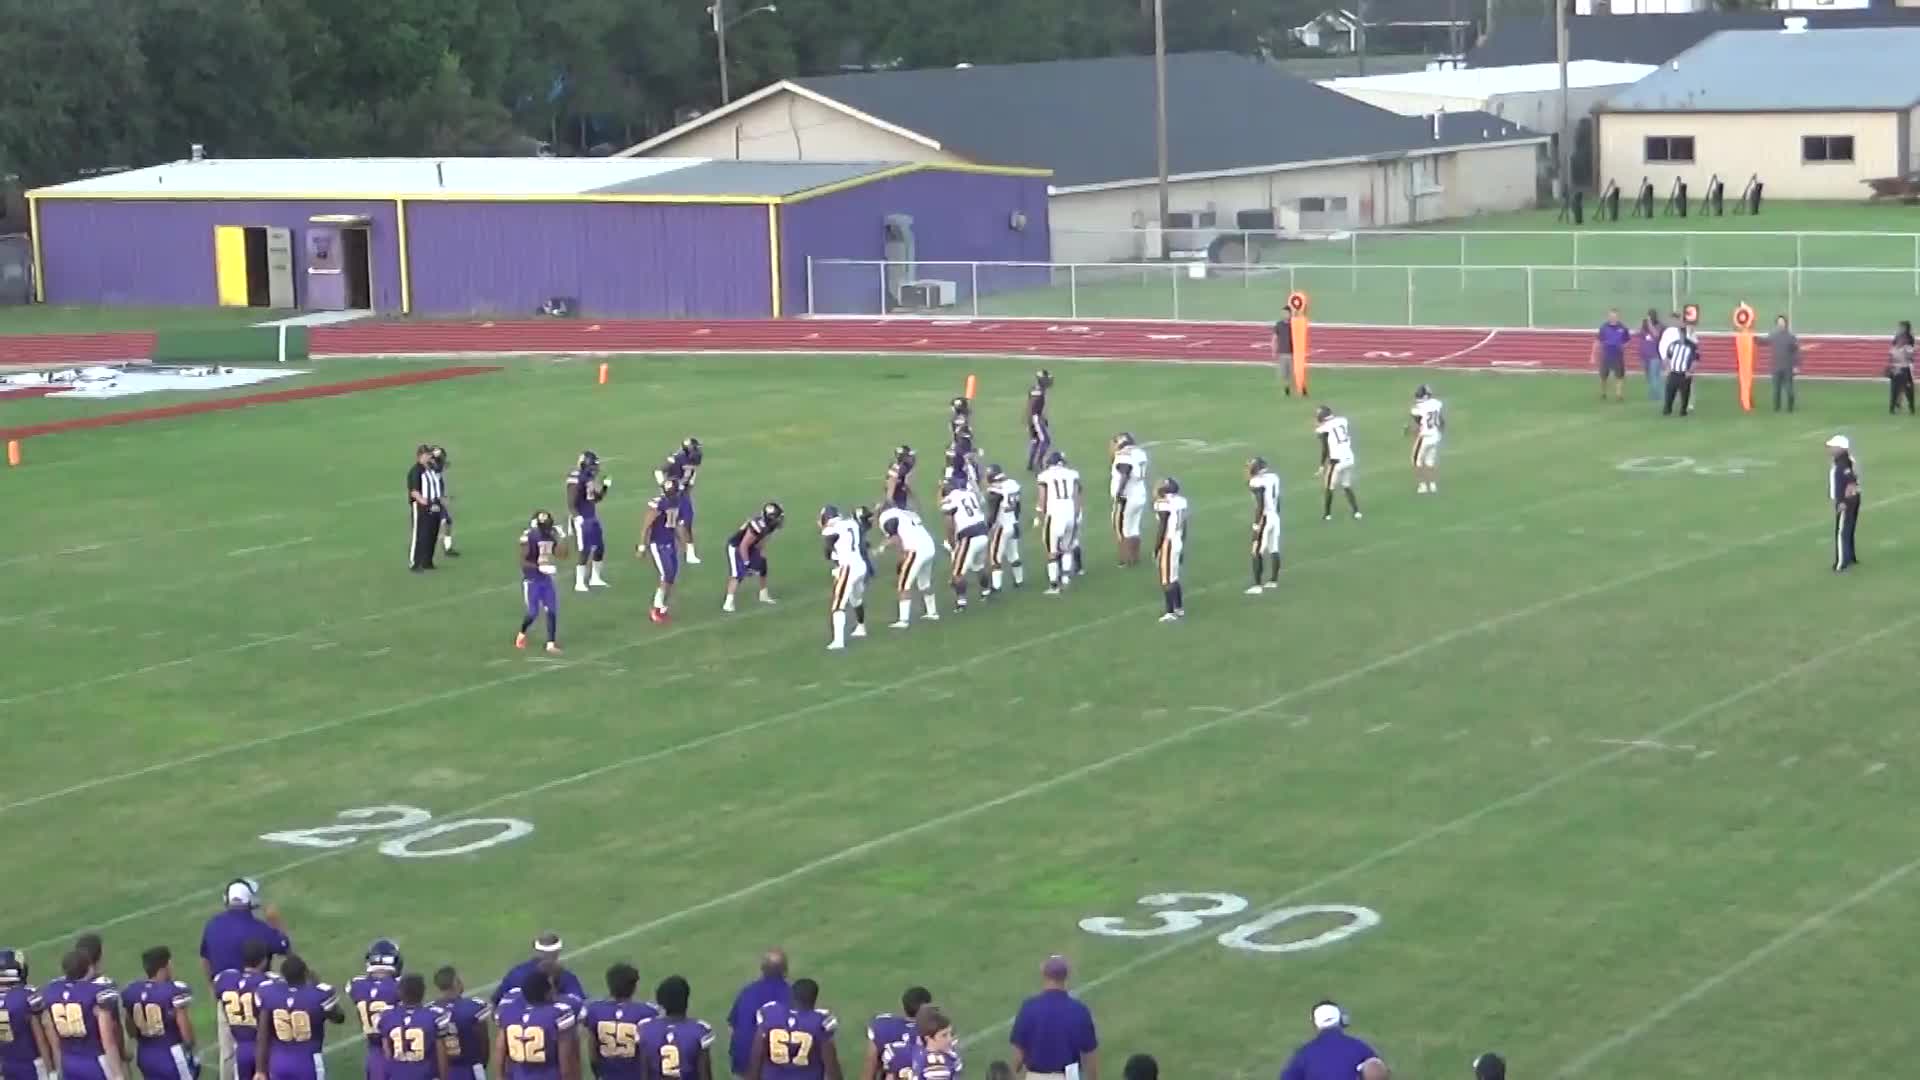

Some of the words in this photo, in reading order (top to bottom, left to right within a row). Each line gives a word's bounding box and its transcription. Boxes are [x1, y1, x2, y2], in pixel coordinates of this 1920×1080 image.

[259, 805, 534, 857] 20
[1078, 892, 1381, 951] 30
[222, 991, 257, 1026] 21
[390, 1027, 424, 1062] 13
[506, 1024, 547, 1063] 62
[597, 1020, 637, 1058] 55
[769, 1028, 813, 1066] 67
[660, 1044, 681, 1077] 2
